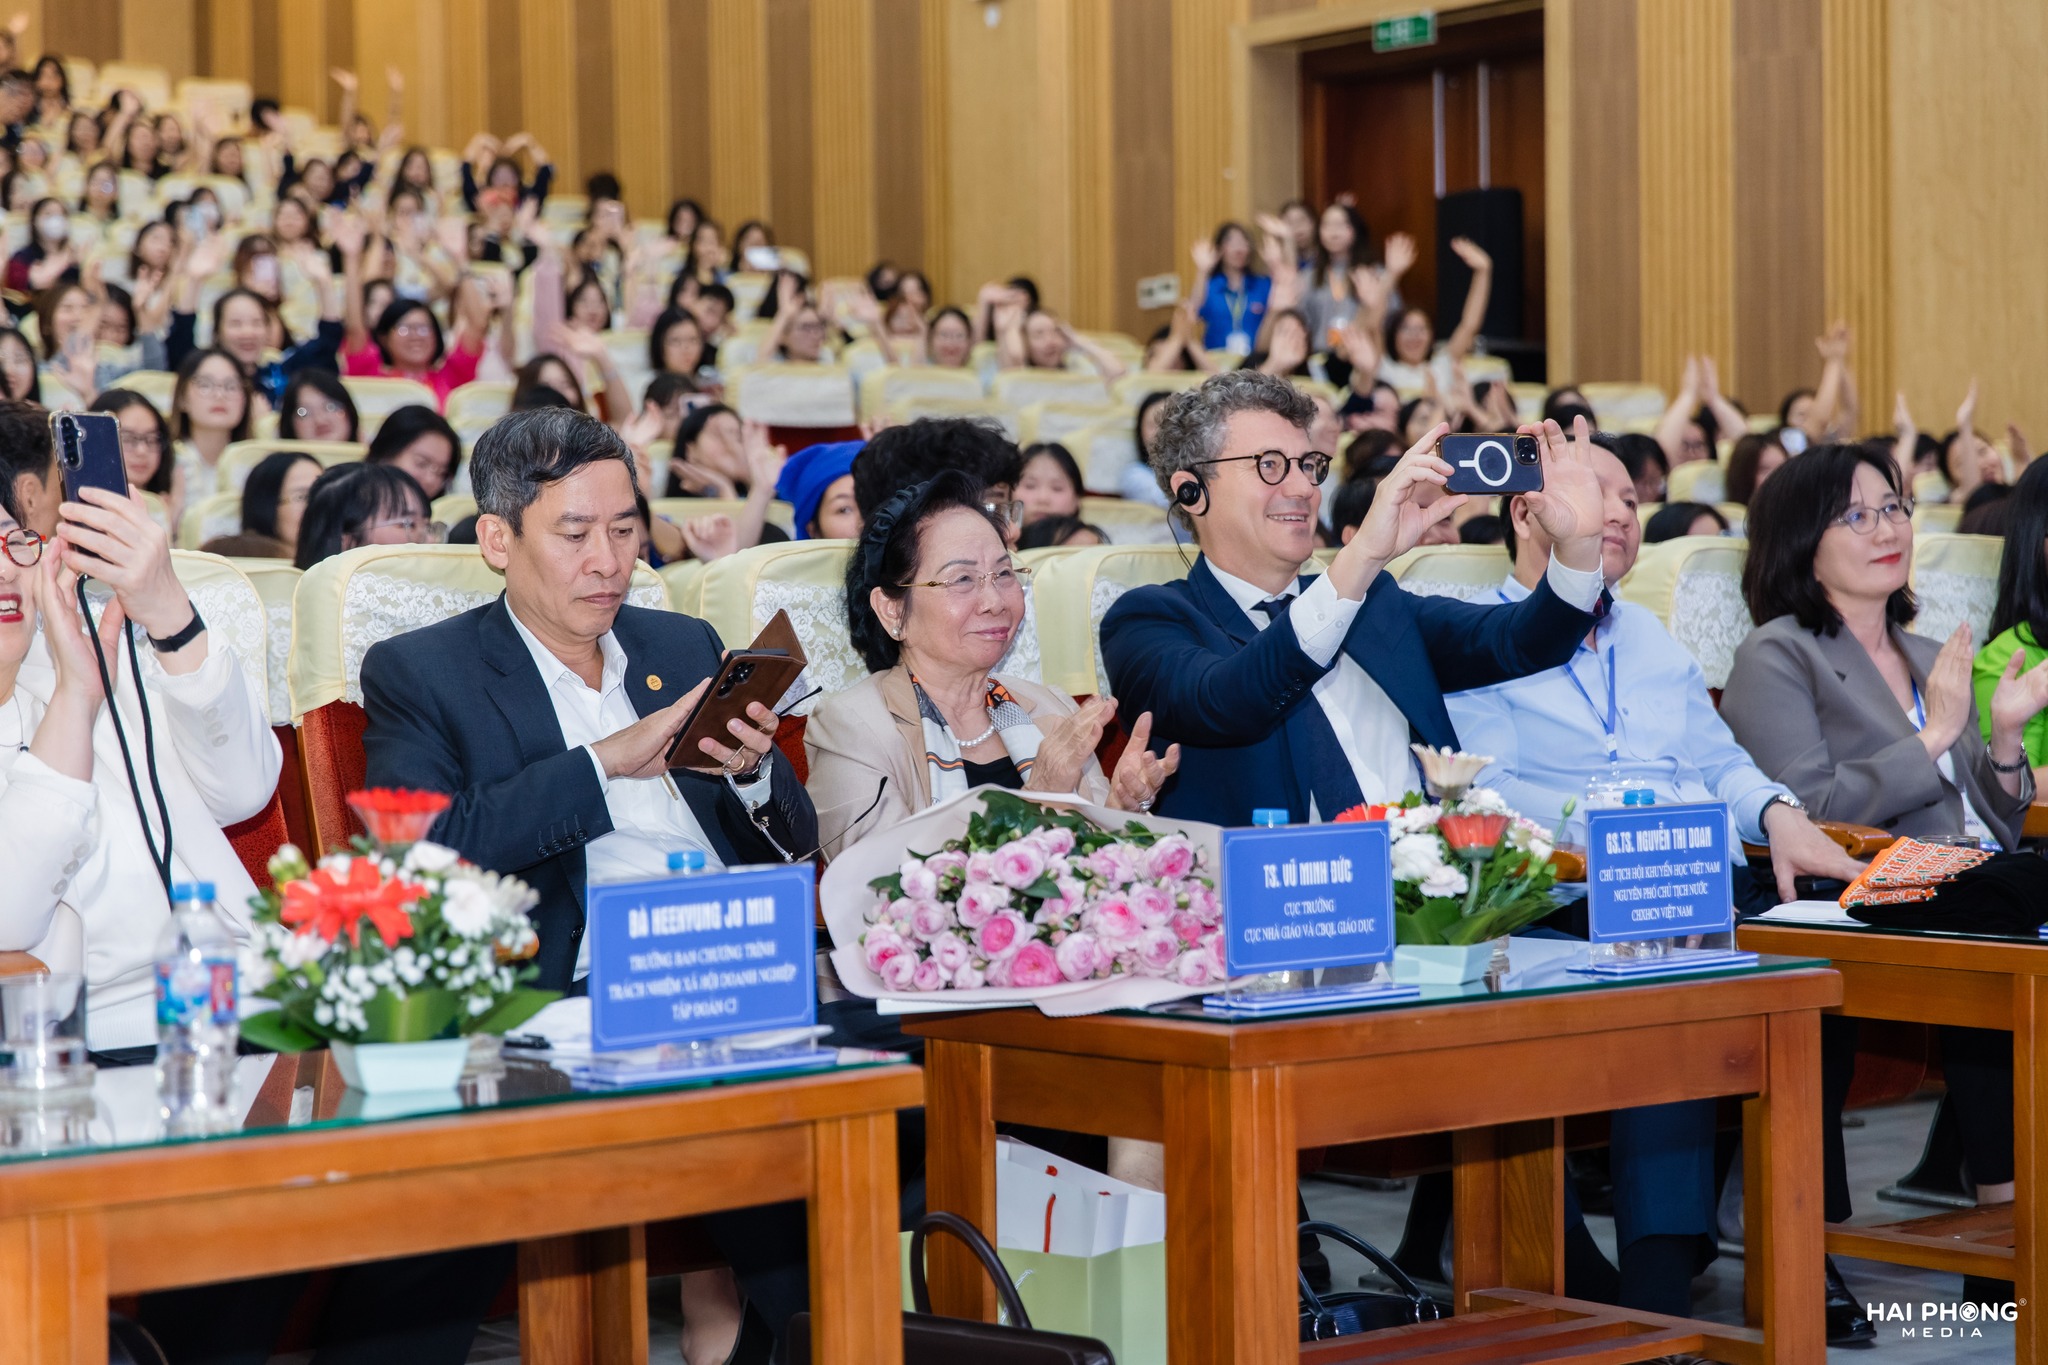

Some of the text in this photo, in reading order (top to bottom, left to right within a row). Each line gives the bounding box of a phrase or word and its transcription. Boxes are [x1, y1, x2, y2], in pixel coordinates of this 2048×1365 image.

[1606, 821, 1712, 854] GS.TS. NGUYỄN THỊ DOAN
[1263, 864, 1280, 888] TS.
[1299, 861, 1328, 886] MINH
[1329, 855, 1352, 884] ĐỨC
[1599, 860, 1720, 882] CHỦ TỊCH HỘI KHUYẾN HỌC VIỆT NAM
[1613, 880, 1708, 901] NGUYÊN PHÓ CHỦ TỊCH NƯỚC
[724, 900, 743, 928] JO
[746, 897, 774, 925] MIN
[1284, 902, 1300, 917] CỤC
[1631, 904, 1693, 921] CHXHCN VIỆT NAM
[1244, 917, 1374, 943] CỤC NHÀ GIÁO VÀ CBQL GIÁO DỤC
